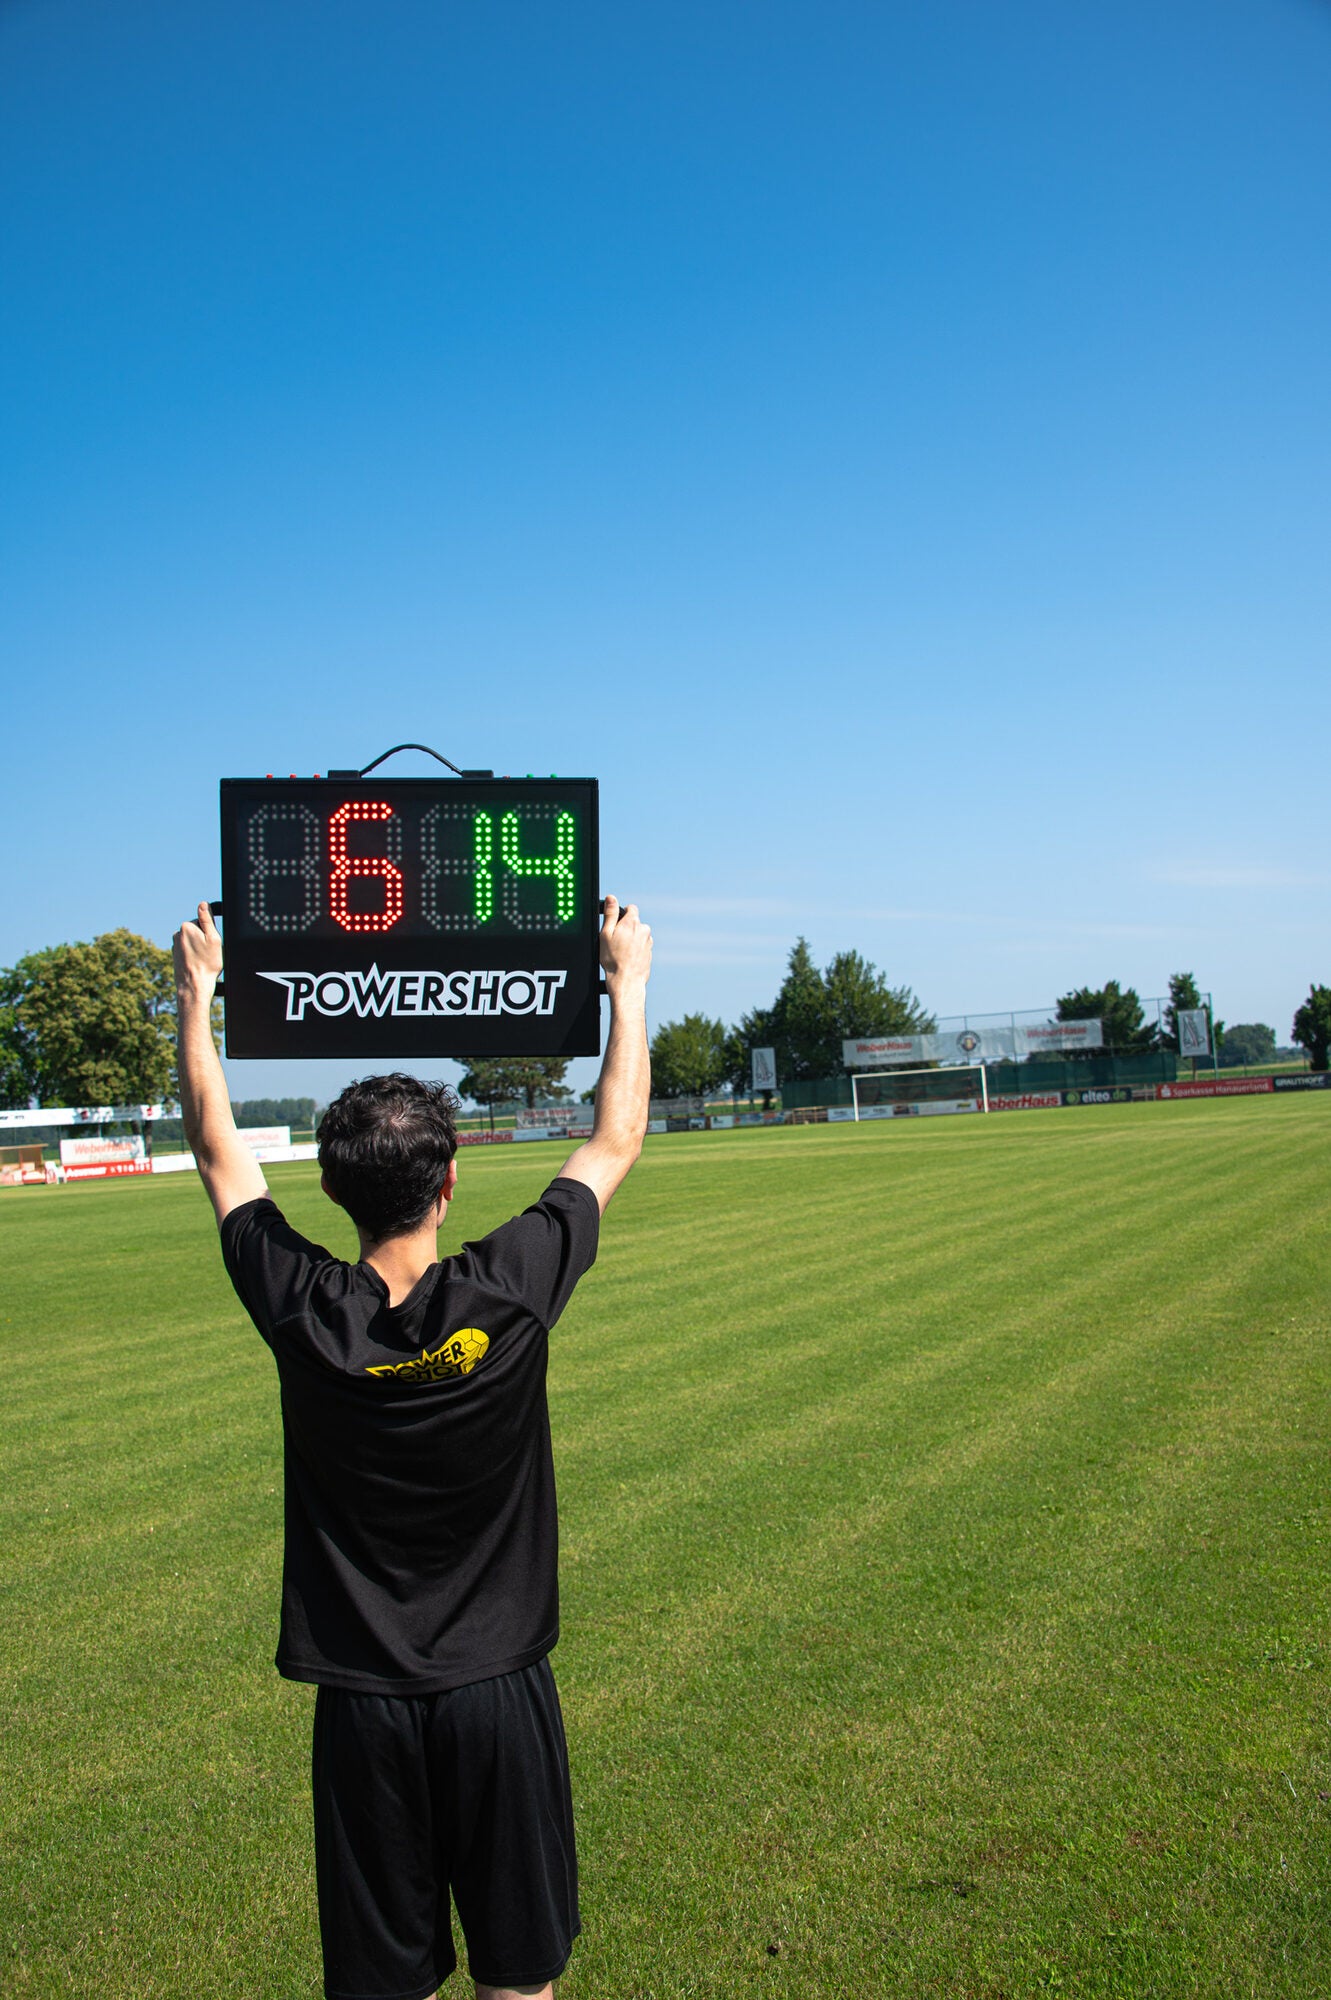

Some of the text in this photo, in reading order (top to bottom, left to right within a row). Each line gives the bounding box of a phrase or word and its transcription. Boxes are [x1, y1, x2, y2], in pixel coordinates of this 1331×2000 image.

[328, 801, 576, 933] 6 14
[255, 962, 568, 1022] POWERSHOT
[976, 1094, 1059, 1111] WeberHaus
[1172, 1087, 1214, 1098] Sparkasse
